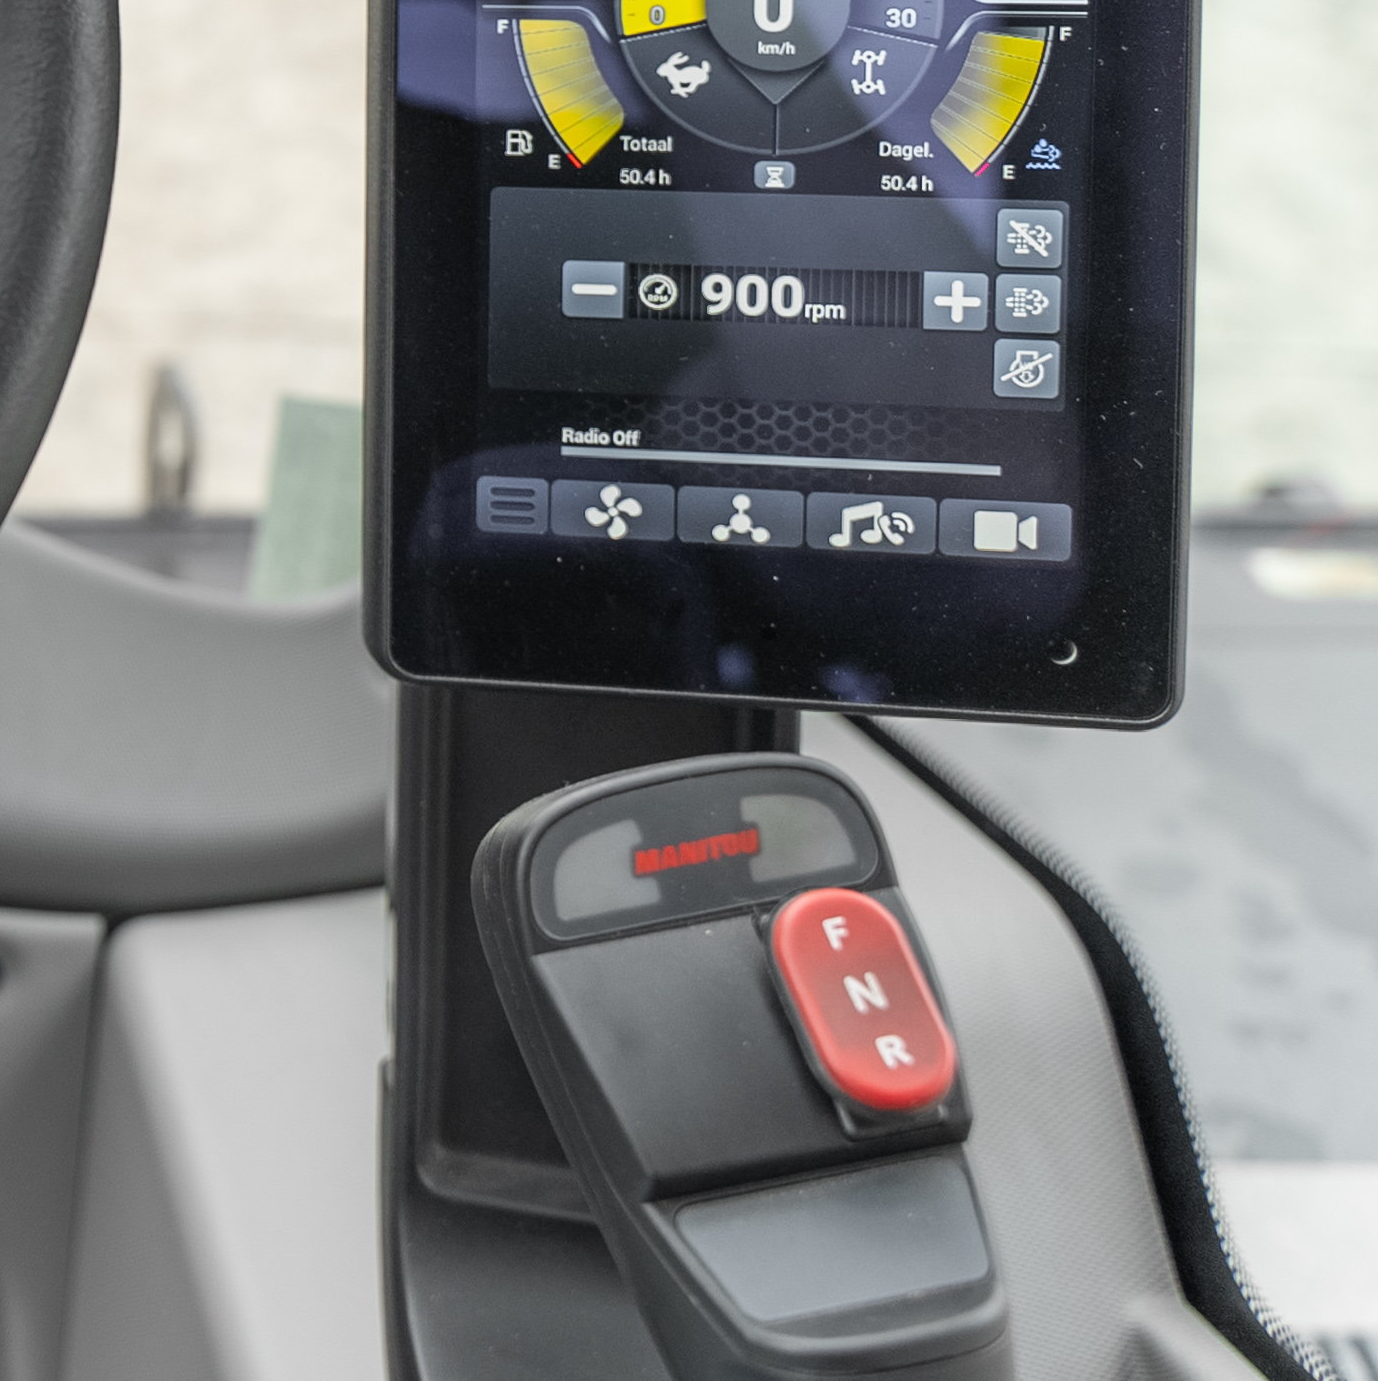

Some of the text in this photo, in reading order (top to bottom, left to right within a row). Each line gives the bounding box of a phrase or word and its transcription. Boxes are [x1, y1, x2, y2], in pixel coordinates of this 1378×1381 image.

[649, 5, 666, 26] 0
[886, 8, 917, 29] 30
[497, 19, 510, 34] F
[1059, 26, 1072, 42] F
[757, 40, 796, 56] km/h
[619, 135, 673, 152] Totaal
[879, 141, 934, 162] Dagel.
[548, 154, 561, 169] E
[1002, 164, 1015, 180] E
[560, 428, 640, 448] Radio Off
[634, 829, 759, 875] MANITOU
[821, 915, 848, 950] F
[843, 972, 888, 1013] N
[874, 1034, 915, 1070] R
